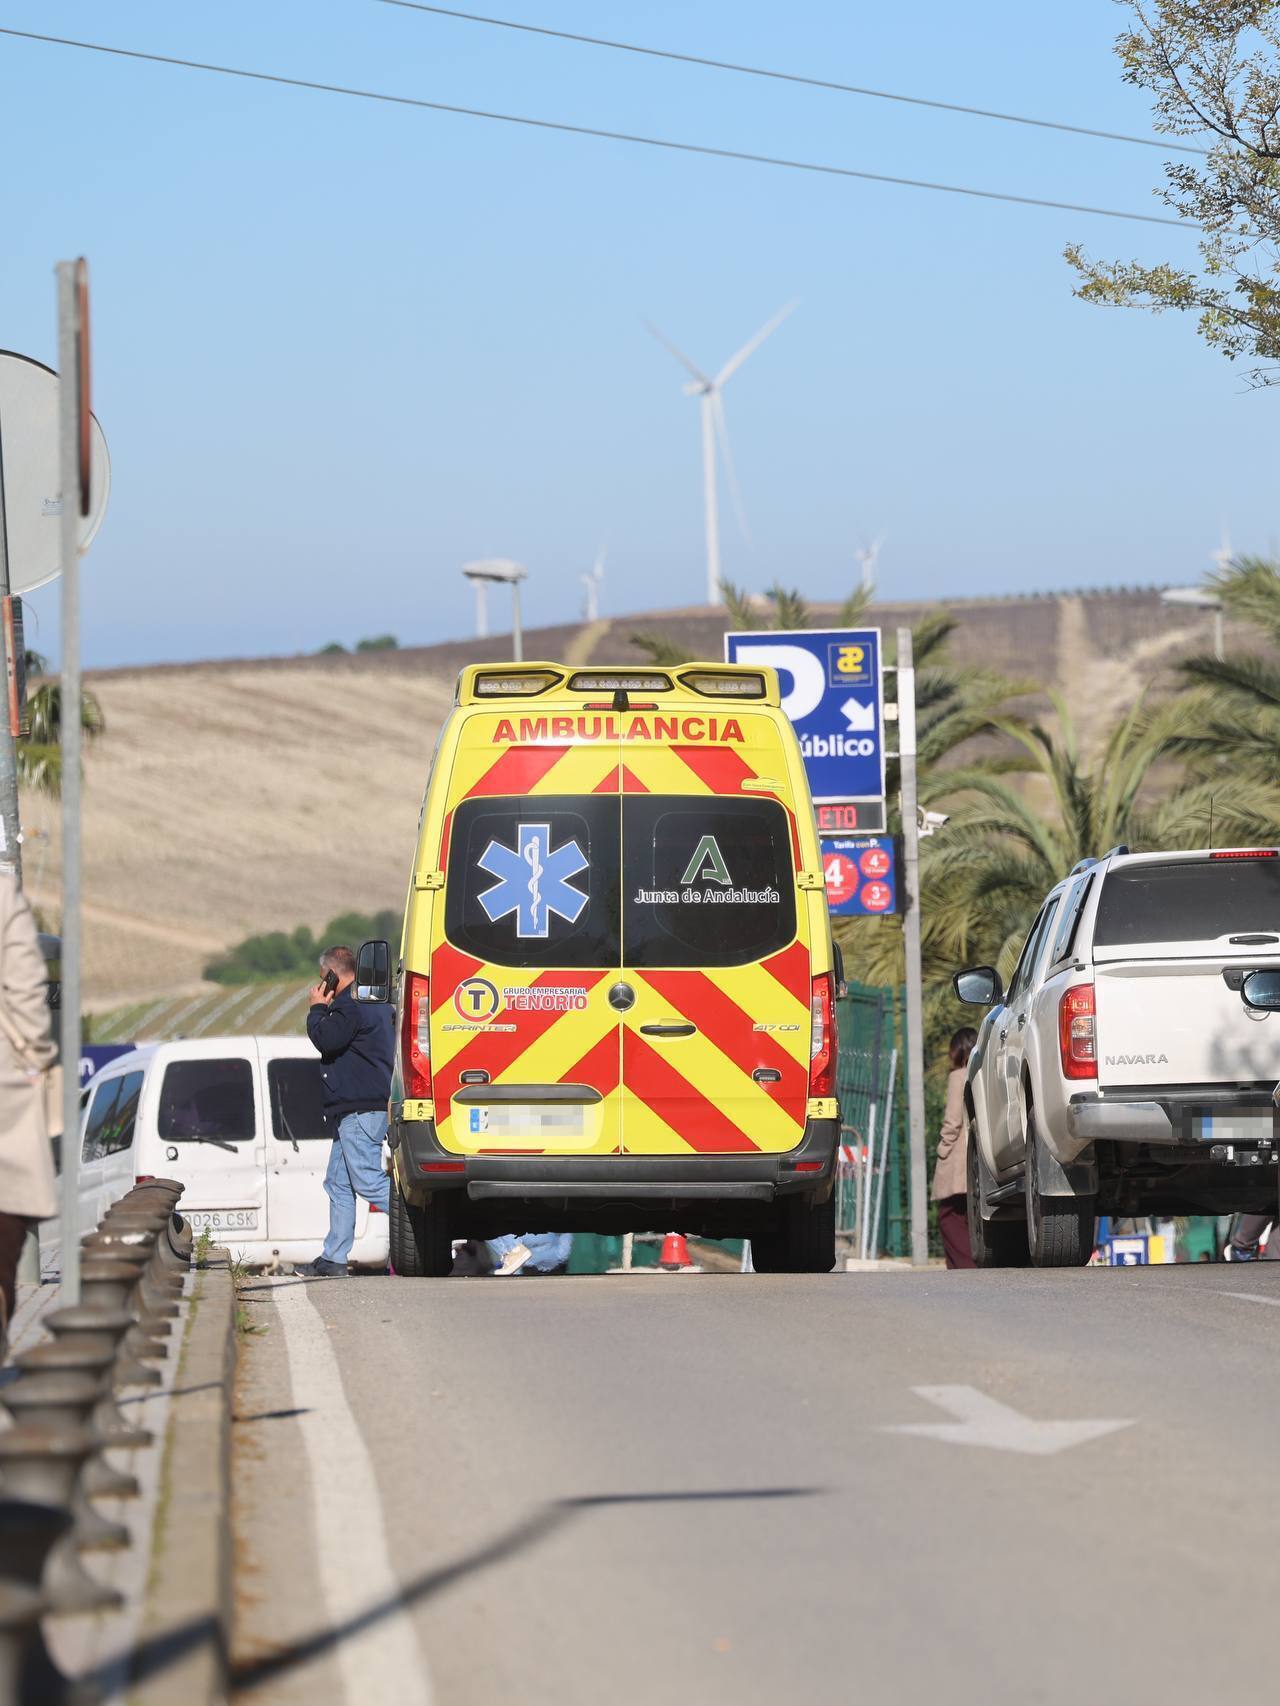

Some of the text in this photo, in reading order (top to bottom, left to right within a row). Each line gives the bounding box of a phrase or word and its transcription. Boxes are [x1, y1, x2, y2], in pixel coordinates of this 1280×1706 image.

[735, 645, 825, 721] P
[492, 717, 745, 743] AMBULANCIA
[799, 733, 875, 757] úblico
[825, 858, 844, 888] 4
[634, 886, 780, 903] Junta de Andalucía
[503, 986, 587, 995] GRUPO EMPRESARIAL
[503, 995, 588, 1010] TENORIO
[441, 1024, 517, 1032] SPRINTER
[1104, 1054, 1169, 1065] NAVARA
[226, 1212, 254, 1226] CSK
